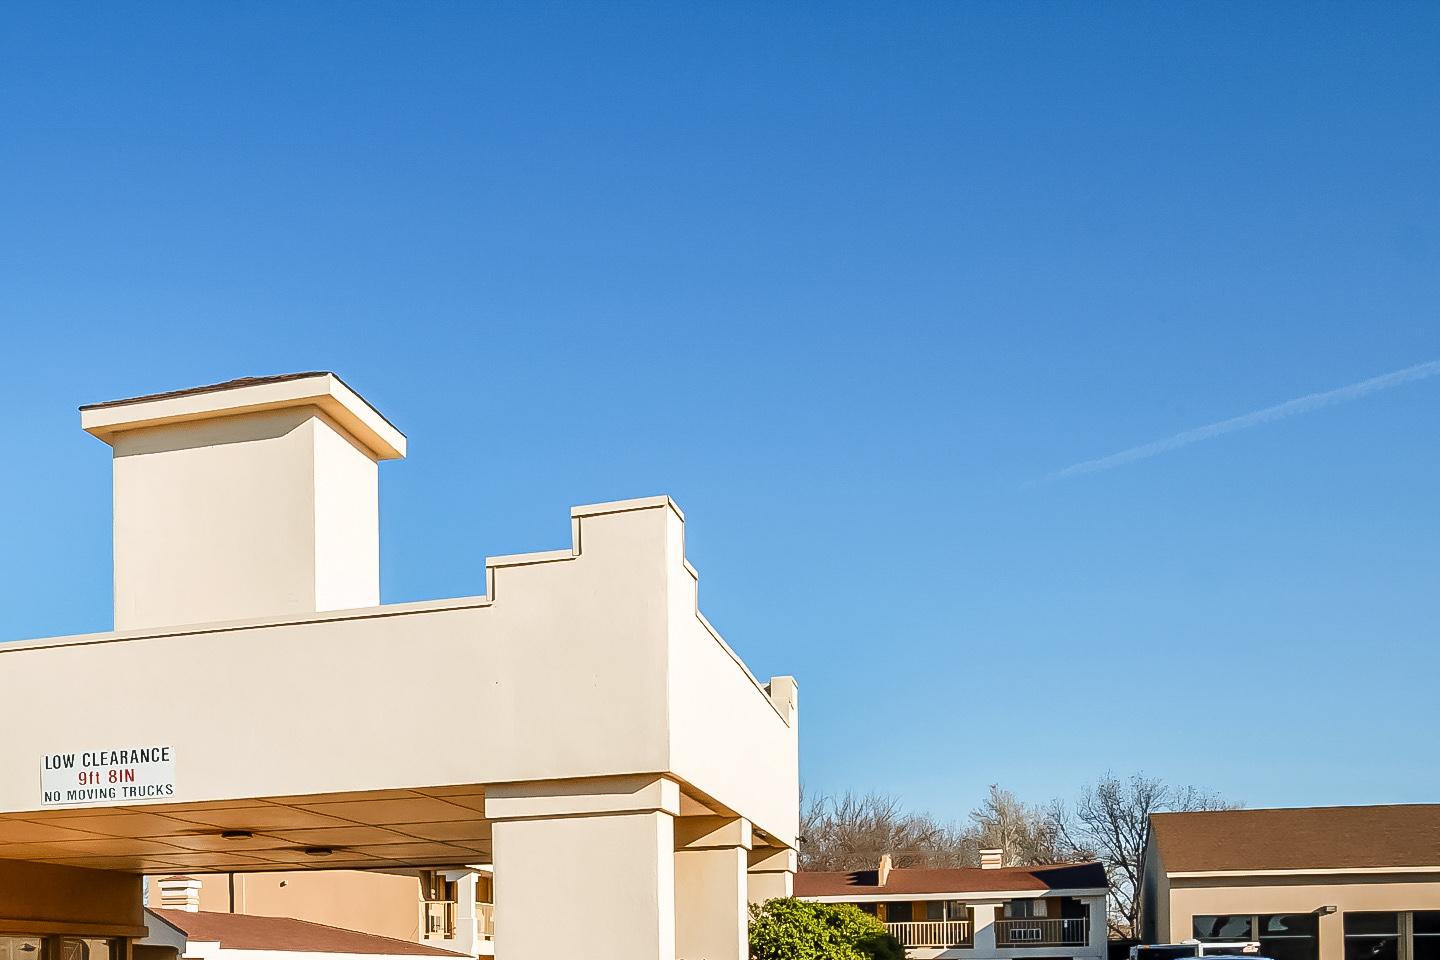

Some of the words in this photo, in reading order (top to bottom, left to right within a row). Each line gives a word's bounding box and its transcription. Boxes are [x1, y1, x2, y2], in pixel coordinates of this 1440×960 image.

[45, 754, 75, 769] LOW
[82, 747, 169, 767] CLEARANCE
[78, 771, 100, 785] 9ft
[108, 769, 134, 783] 8IN
[44, 791, 61, 802] NO
[67, 788, 116, 800] MOVING
[122, 784, 173, 797] TRUCKS
